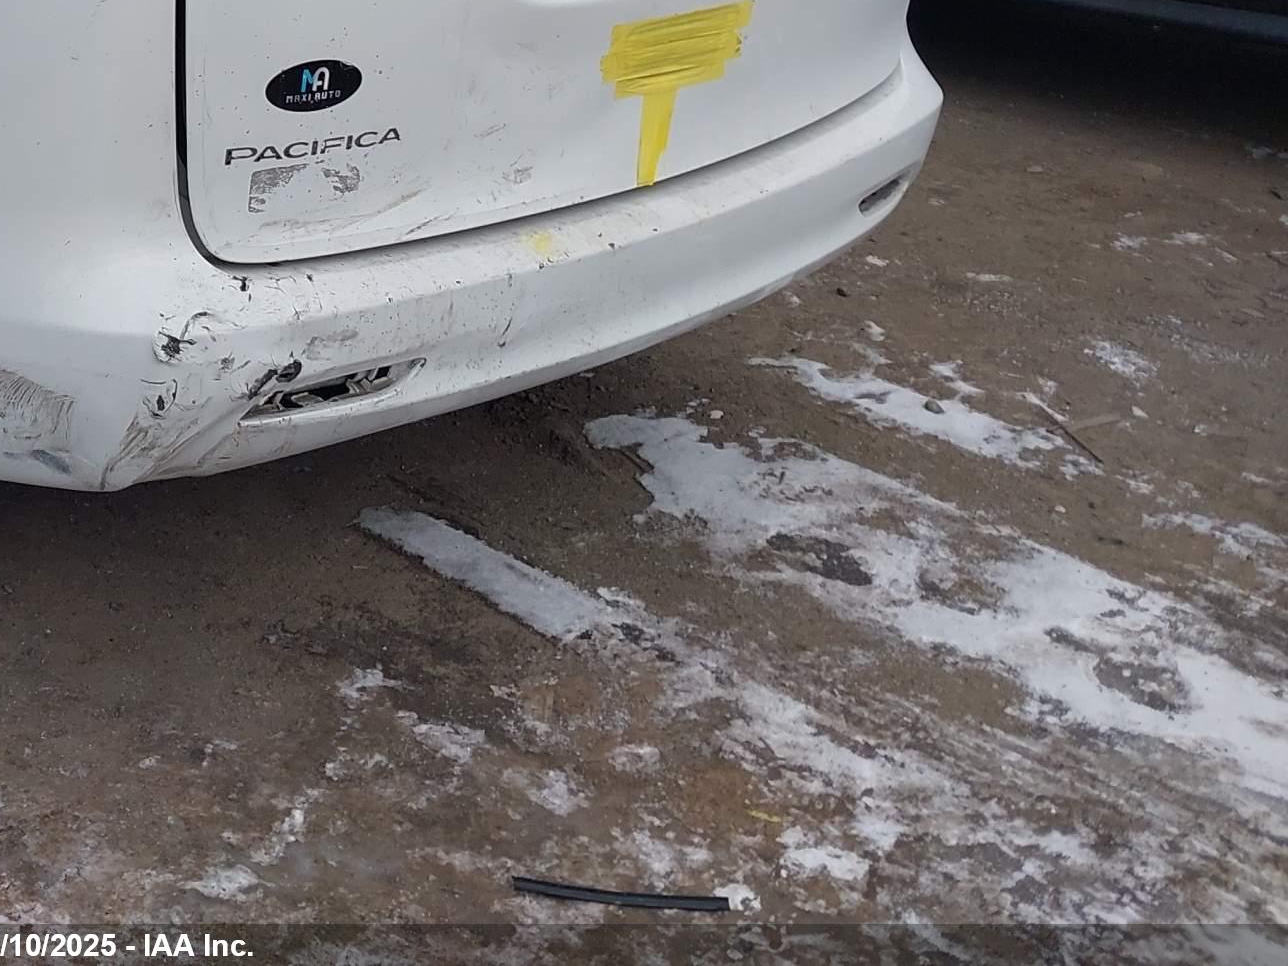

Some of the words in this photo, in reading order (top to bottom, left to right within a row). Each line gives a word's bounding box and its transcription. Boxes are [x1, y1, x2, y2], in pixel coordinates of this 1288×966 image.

[285, 92, 312, 104] MAXI
[314, 89, 341, 102] AUTO
[224, 128, 401, 166] PACIFICA
